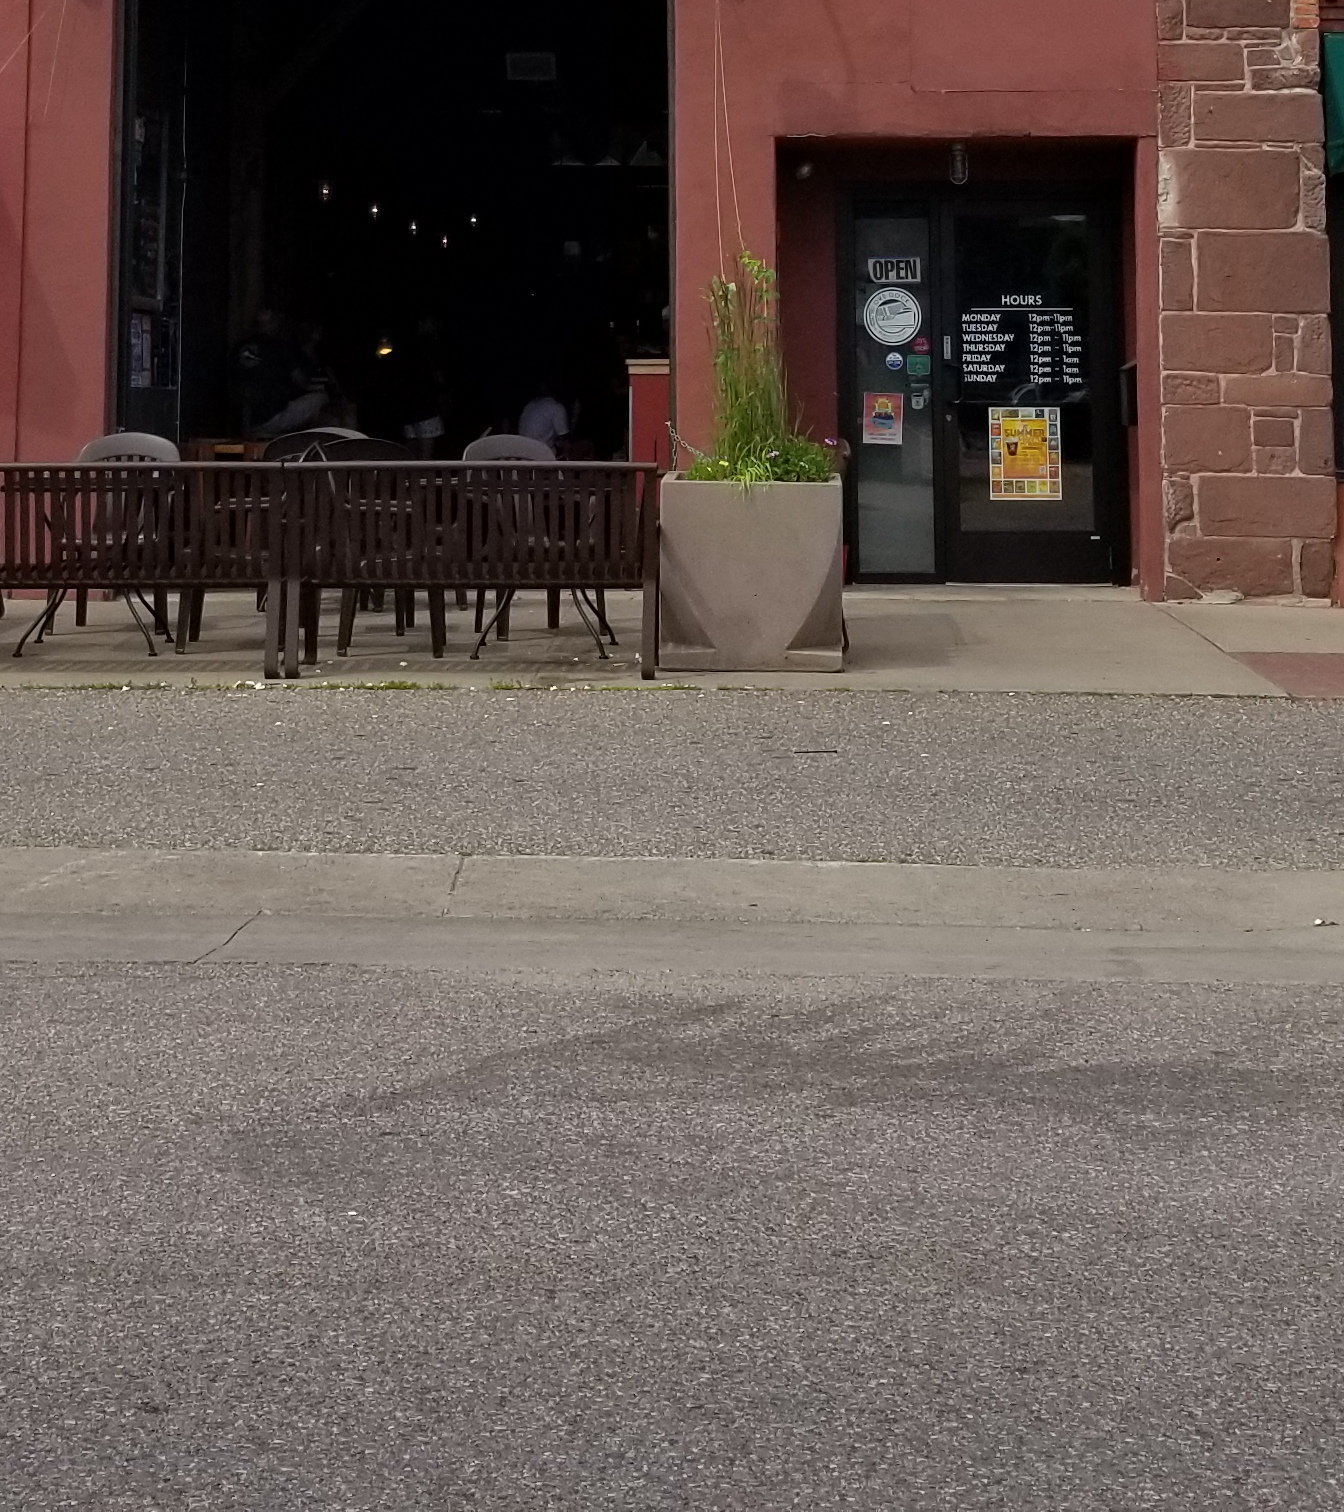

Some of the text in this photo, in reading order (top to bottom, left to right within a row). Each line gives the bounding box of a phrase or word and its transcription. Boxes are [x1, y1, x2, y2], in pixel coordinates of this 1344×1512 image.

[872, 258, 918, 281] OPEN
[1001, 294, 1043, 306] HOURS
[961, 313, 1073, 324] MONDAY 12pm-11pm
[961, 323, 1074, 334] TUESDAY 12pm-11pm
[962, 333, 1015, 342] WEDNESDAY
[1029, 334, 1052, 344] 12pm
[1062, 334, 1082, 344] 11pm
[962, 343, 1006, 352] THURSDAY
[1029, 344, 1052, 354] 12pm
[1062, 344, 1082, 354] 11pm
[962, 354, 992, 363] FRIDAY
[1029, 354, 1052, 364] 12pm
[1062, 354, 1080, 363] 1am
[962, 364, 1006, 373] SATURDAY
[1029, 364, 1052, 374] 12pm
[1062, 364, 1080, 373] 1am
[962, 374, 998, 383] SUNDAY
[1029, 375, 1052, 385] 12pm
[1062, 375, 1083, 385] 11pm
[1004, 428, 1045, 437] SUMMER
